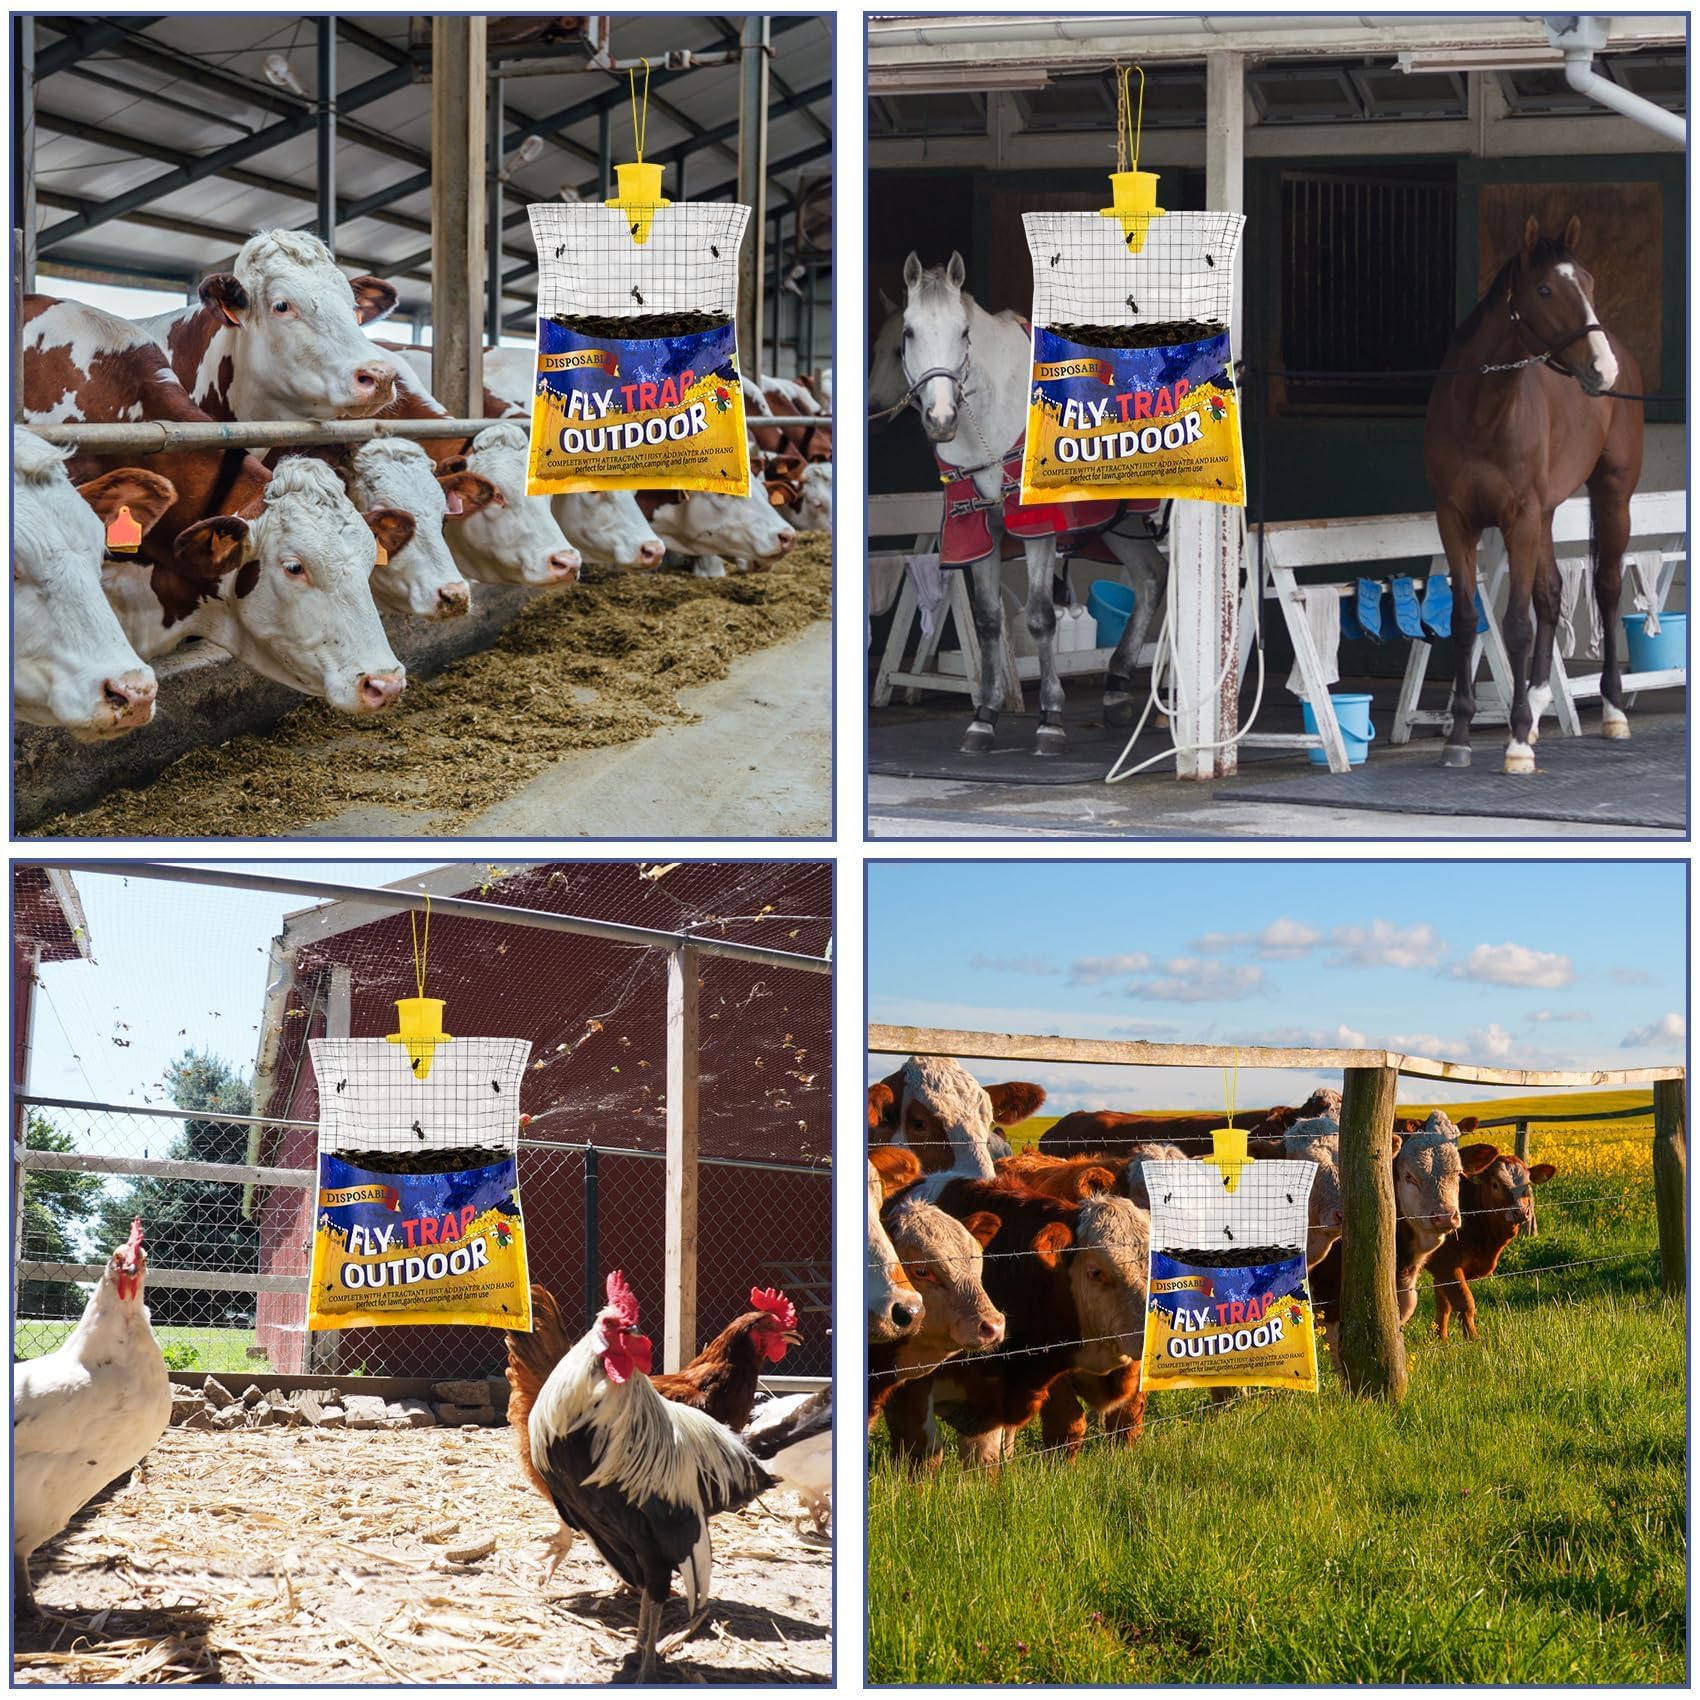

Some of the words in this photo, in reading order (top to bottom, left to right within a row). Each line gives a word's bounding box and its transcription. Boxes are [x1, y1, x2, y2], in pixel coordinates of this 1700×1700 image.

[566, 388, 614, 421] FLY
[620, 369, 696, 414] TRAP
[1061, 397, 1109, 430] FLY
[1115, 378, 1191, 423] TRAP
[562, 402, 709, 454] OUTDOOR
[1057, 411, 1204, 463] OUTDOOR
[547, 458, 582, 468] COMPLETE
[583, 457, 600, 465] WITH
[602, 454, 644, 464] ATTRACTANT
[663, 451, 677, 459] ADD
[700, 448, 714, 456] AND
[575, 464, 596, 474] perfect
[597, 464, 606, 472] for
[670, 457, 682, 465] and
[682, 456, 696, 465] farm
[1042, 468, 1077, 476] COMPLETE
[1078, 466, 1095, 474] WITH
[1096, 463, 1139, 472] ATTRACTANT
[1158, 460, 1172, 468] ADD
[1173, 458, 1194, 466] WATER
[1070, 474, 1091, 482] perfect
[1092, 472, 1101, 480] for
[1165, 466, 1176, 474] and
[1178, 466, 1192, 474] farm
[347, 1223, 395, 1256] FLY
[401, 1204, 477, 1249] TRAP
[343, 1237, 490, 1289] OUTDOOR
[328, 1294, 363, 1302] COMPLETE
[364, 1292, 381, 1300] WITH
[382, 1289, 425, 1298] ATTRACTANT
[444, 1286, 458, 1294] ADD
[459, 1284, 480, 1292] WATER
[356, 1300, 377, 1308] perfect
[378, 1298, 387, 1306] for
[451, 1292, 462, 1300] and
[464, 1292, 478, 1300] farm
[1172, 1306, 1210, 1332] FLY
[1215, 1291, 1275, 1327] TRAP
[1169, 1317, 1285, 1359] OUTDOOR
